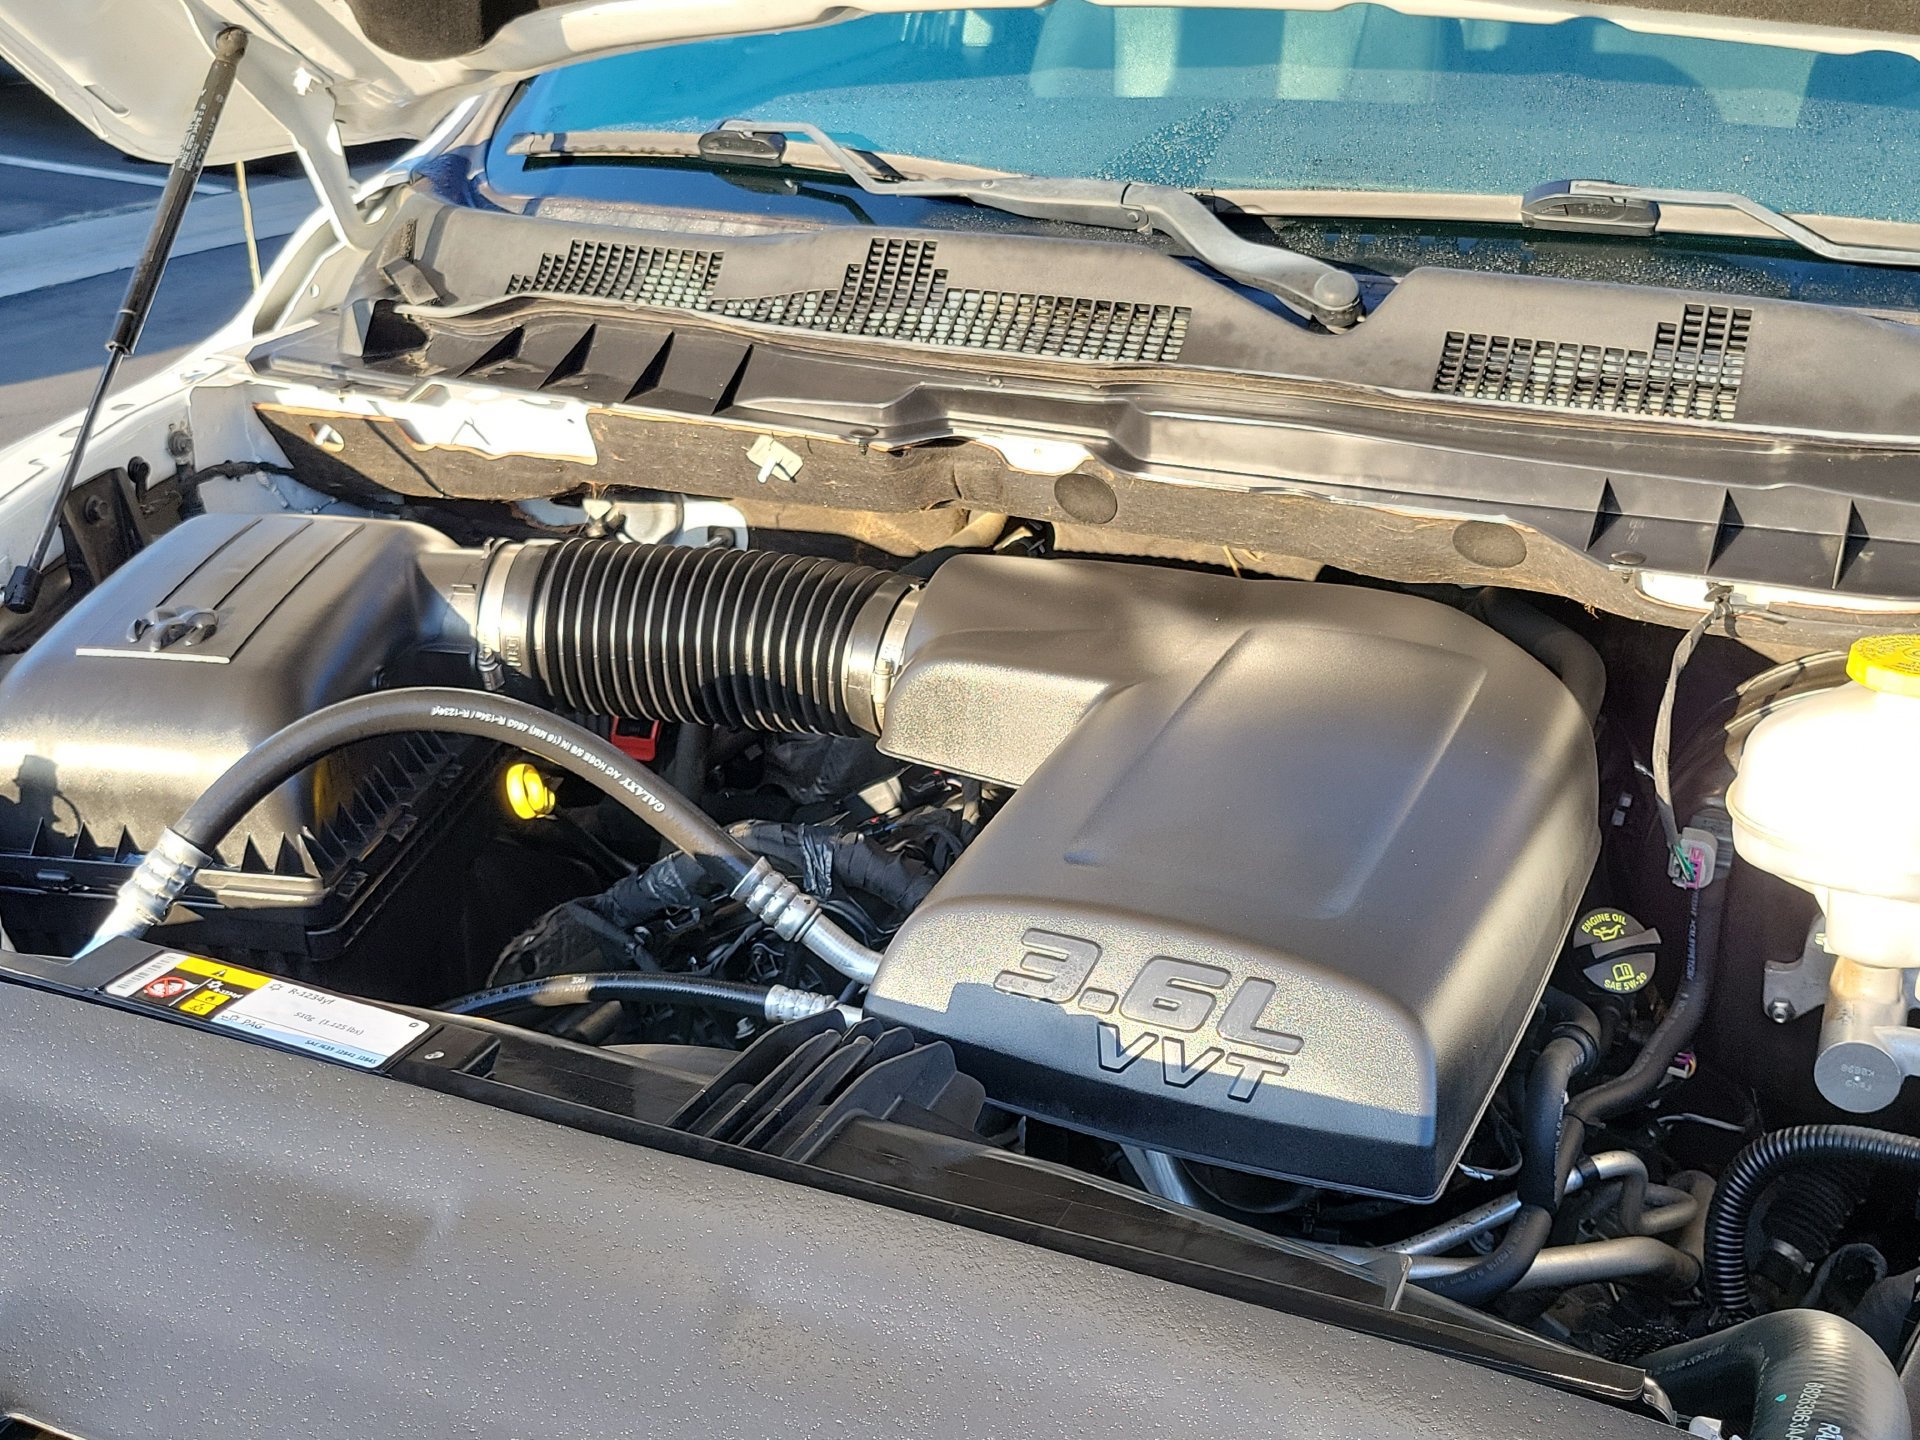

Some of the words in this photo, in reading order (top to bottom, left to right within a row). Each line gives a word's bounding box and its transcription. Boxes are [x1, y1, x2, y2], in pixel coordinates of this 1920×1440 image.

[582, 752, 607, 771] HOSE
[619, 777, 666, 813] GALAXY
[1581, 912, 1611, 933] ENGINE
[1612, 913, 1627, 926] OIL
[993, 927, 1305, 1056] 3.6L
[1604, 979, 1622, 991] SAE
[1623, 972, 1648, 991] 5W-20
[288, 987, 336, 1005] R-1234yf
[241, 1018, 266, 1030] PAG
[1096, 1020, 1290, 1104] VVT
